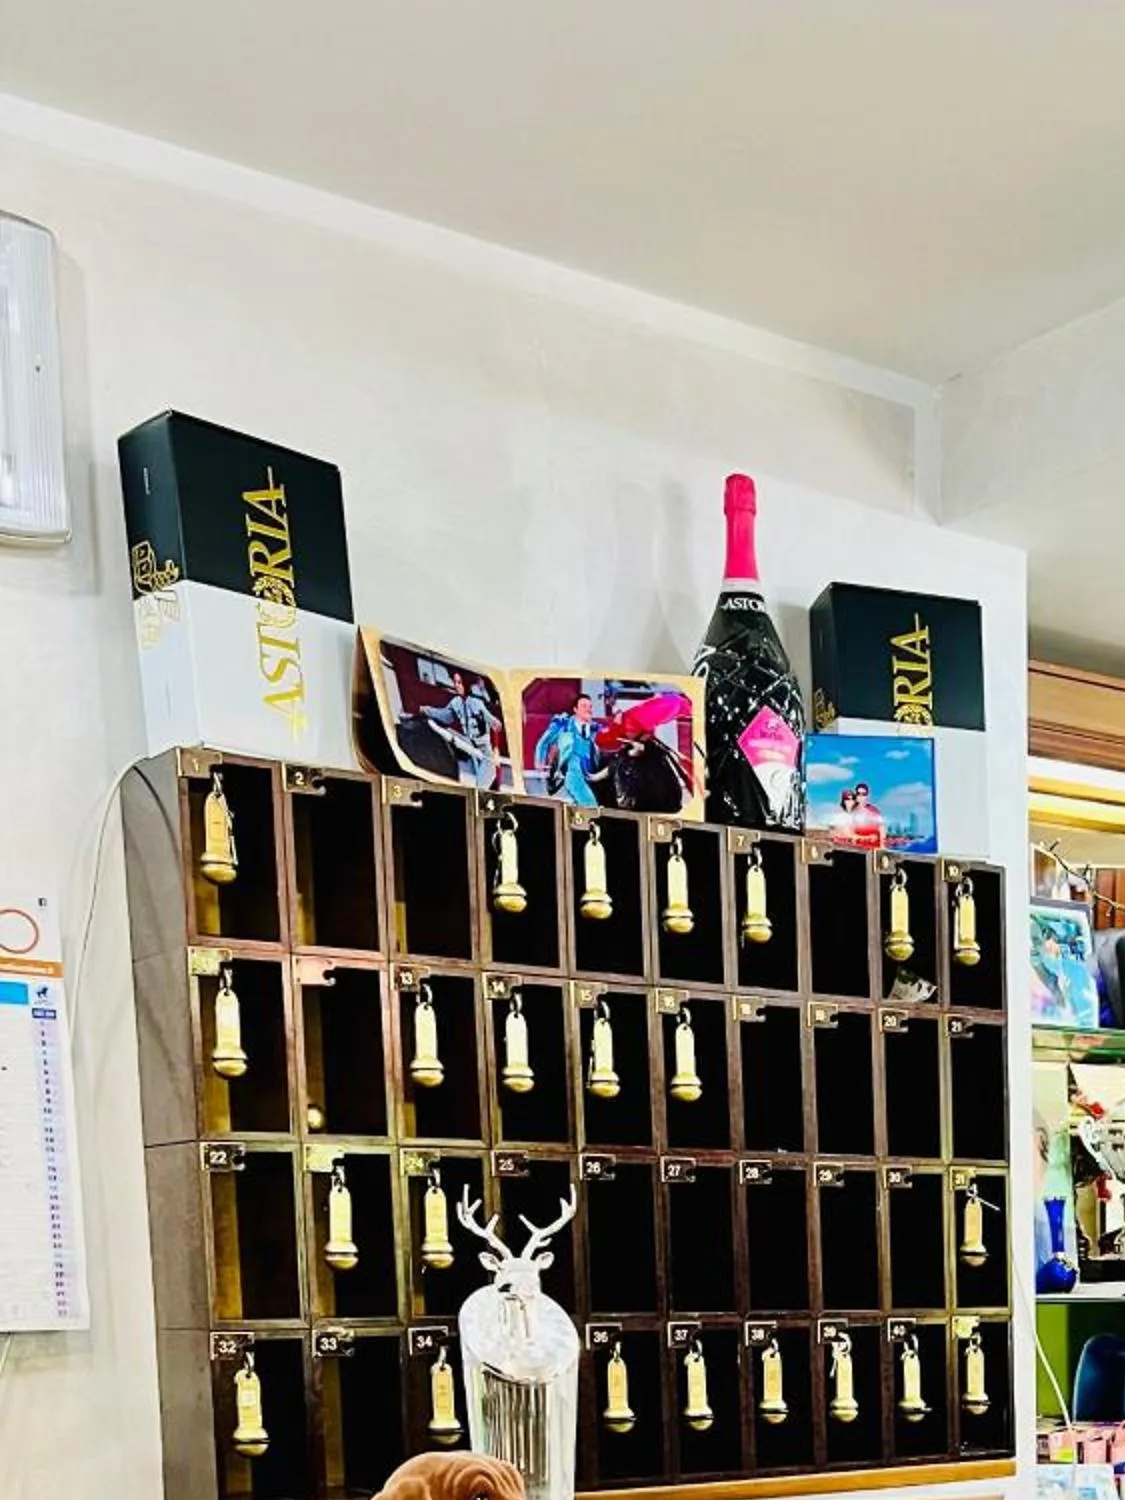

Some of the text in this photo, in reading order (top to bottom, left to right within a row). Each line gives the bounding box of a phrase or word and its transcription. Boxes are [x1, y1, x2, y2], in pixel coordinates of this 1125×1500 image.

[242, 466, 306, 732] ASTORIA
[891, 612, 934, 738] ORIA
[294, 770, 305, 786] 2
[392, 783, 403, 799] 3
[735, 834, 745, 848] 7
[884, 1015, 897, 1028] 20
[209, 1150, 227, 1165] 22
[498, 1159, 515, 1172] 25
[585, 1160, 601, 1174] 26
[667, 1164, 682, 1177] 27
[415, 1335, 433, 1349] 34
[592, 1330, 609, 1344] 36
[673, 1328, 689, 1342] 37
[218, 1339, 238, 1354] 32
[319, 1337, 337, 1351] 33
